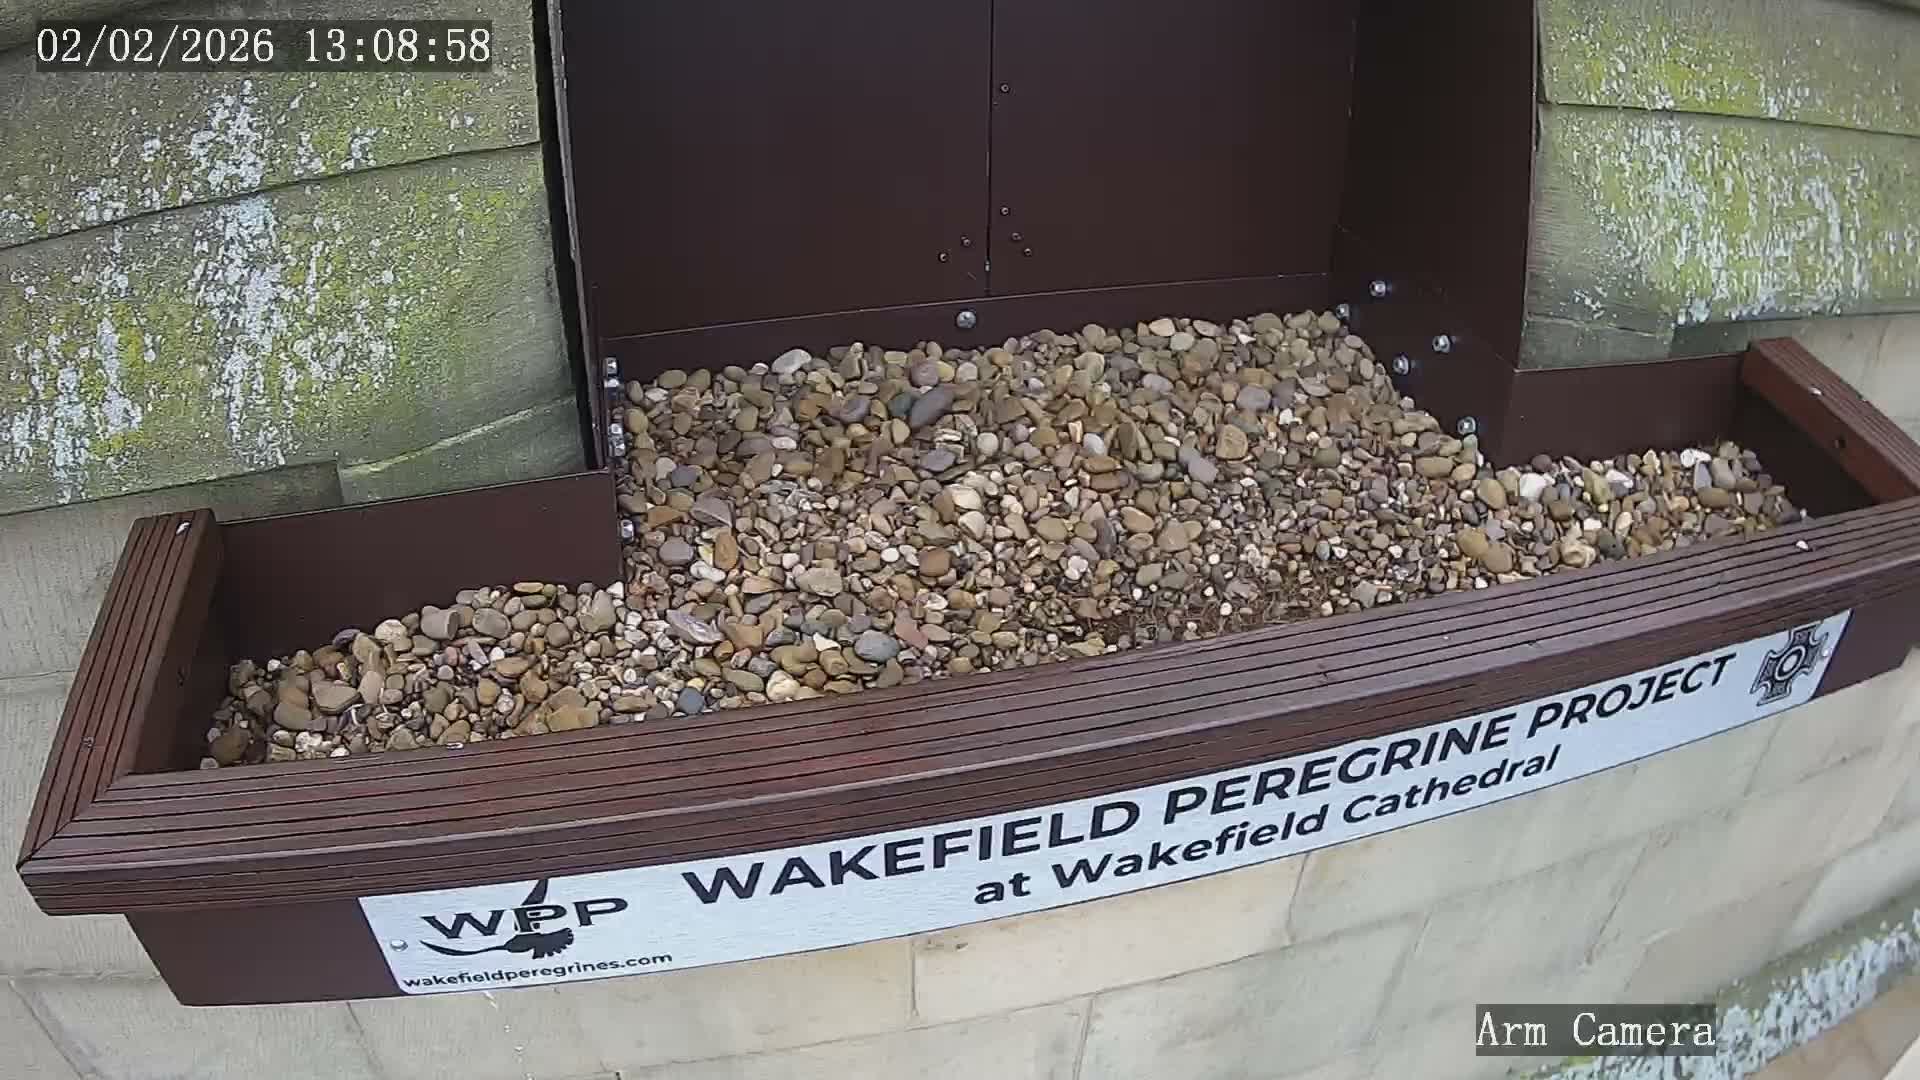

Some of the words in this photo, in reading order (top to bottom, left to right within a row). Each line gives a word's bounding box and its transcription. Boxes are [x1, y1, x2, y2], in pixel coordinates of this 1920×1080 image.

[681, 801, 1141, 906] WAKEFIELD
[1163, 712, 1518, 825] PEREGRINE
[1526, 652, 1737, 740] PROJECT
[974, 872, 1031, 905] at
[1051, 804, 1329, 890] Wakefield
[1342, 744, 1562, 824] Cathedral
[420, 897, 629, 939] WPP
[402, 952, 674, 988] wakefieldperegrines.com
